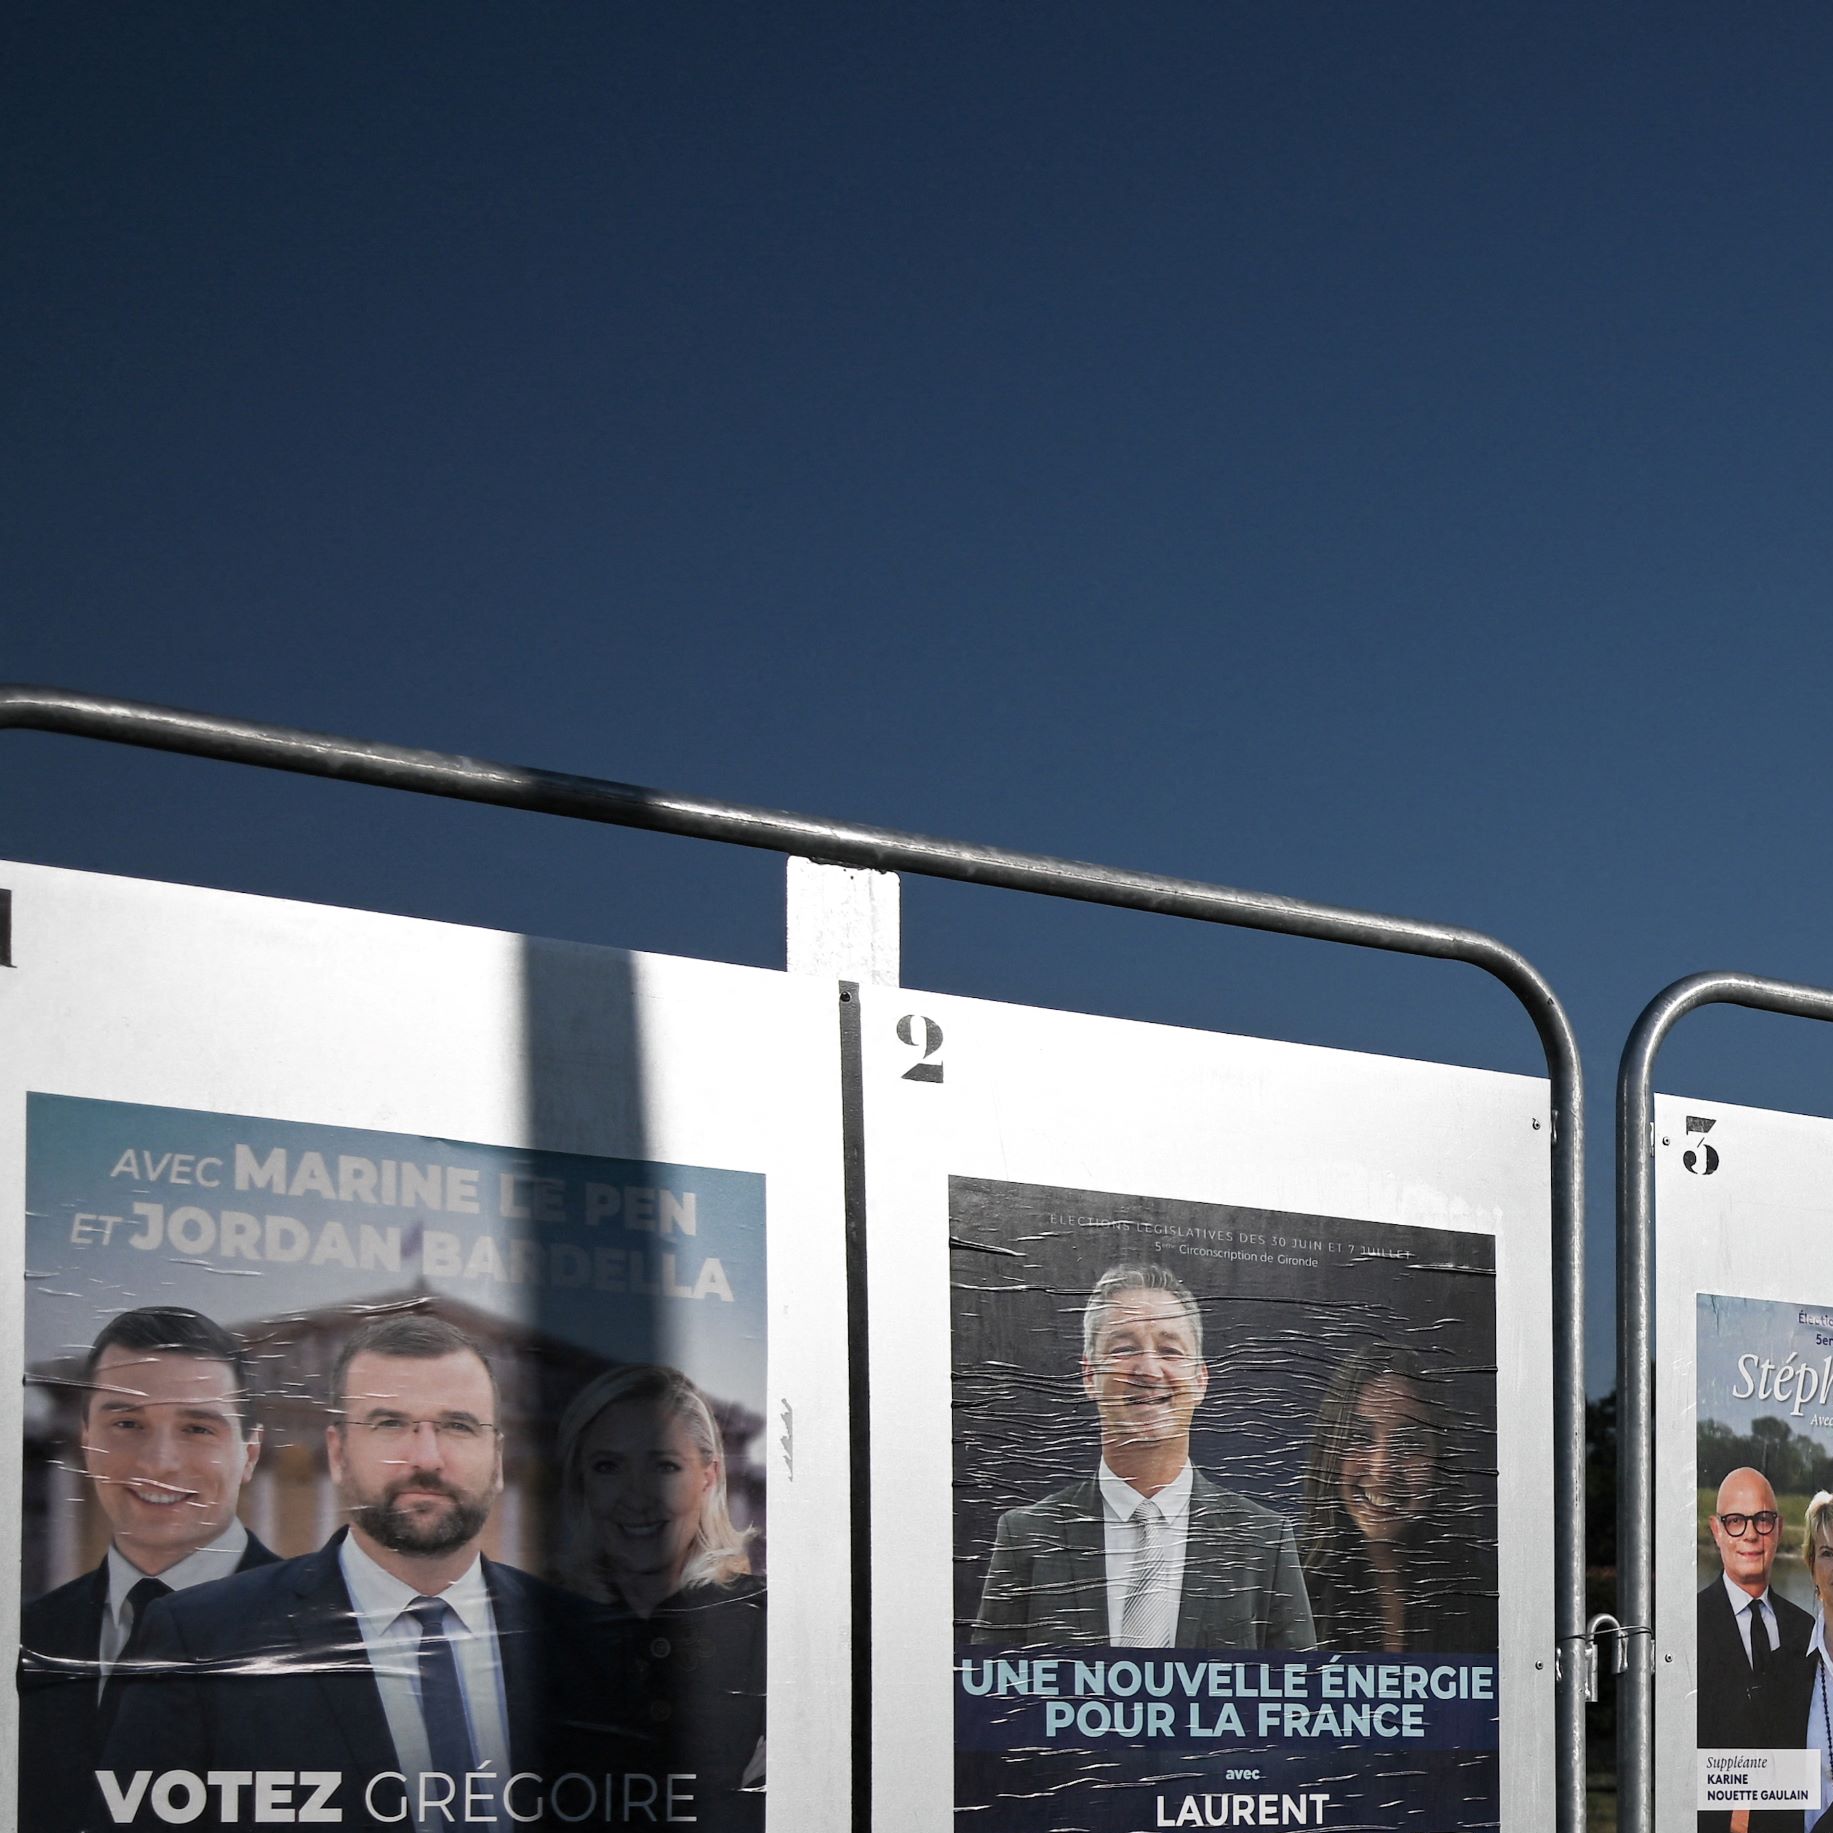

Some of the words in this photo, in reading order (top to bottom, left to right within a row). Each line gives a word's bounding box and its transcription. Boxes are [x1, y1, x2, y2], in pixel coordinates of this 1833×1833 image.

[896, 1013, 944, 1083] 2
[1683, 1115, 1719, 1176] 3
[111, 1148, 224, 1189] AVEC
[232, 1143, 481, 1214] MARINE
[498, 1173, 565, 1223] LE
[585, 1179, 697, 1237] PEN
[69, 1213, 123, 1248] ET
[130, 1201, 400, 1272] JORDAN
[421, 1232, 735, 1303] BARDELLA
[1179, 1244, 1257, 1264] Circonscription
[1260, 1249, 1274, 1262] de
[1277, 1250, 1319, 1268] Gironde
[1239, 1233, 1265, 1245] DES
[1271, 1236, 1286, 1248] 30
[1292, 1238, 1322, 1251] JUIN
[961, 1659, 1060, 1697] UNE
[1074, 1659, 1308, 1699] NOUVELLE
[1322, 1655, 1494, 1700] ÉNERGIE
[1045, 1703, 1175, 1738] POUR
[1189, 1703, 1245, 1737] LA
[1259, 1703, 1425, 1738] FRANCE
[1225, 1768, 1260, 1781] avec
[1706, 1755, 1767, 1772] Suppléante
[1707, 1773, 1748, 1785] KARINE
[95, 1770, 343, 1824] VOTEZ
[365, 1760, 699, 1823] GRÉGOIRE
[1707, 1789, 1758, 1801] NOUETTE
[1760, 1788, 1808, 1800] GAULAIN
[1156, 1793, 1330, 1827] LAURENT
